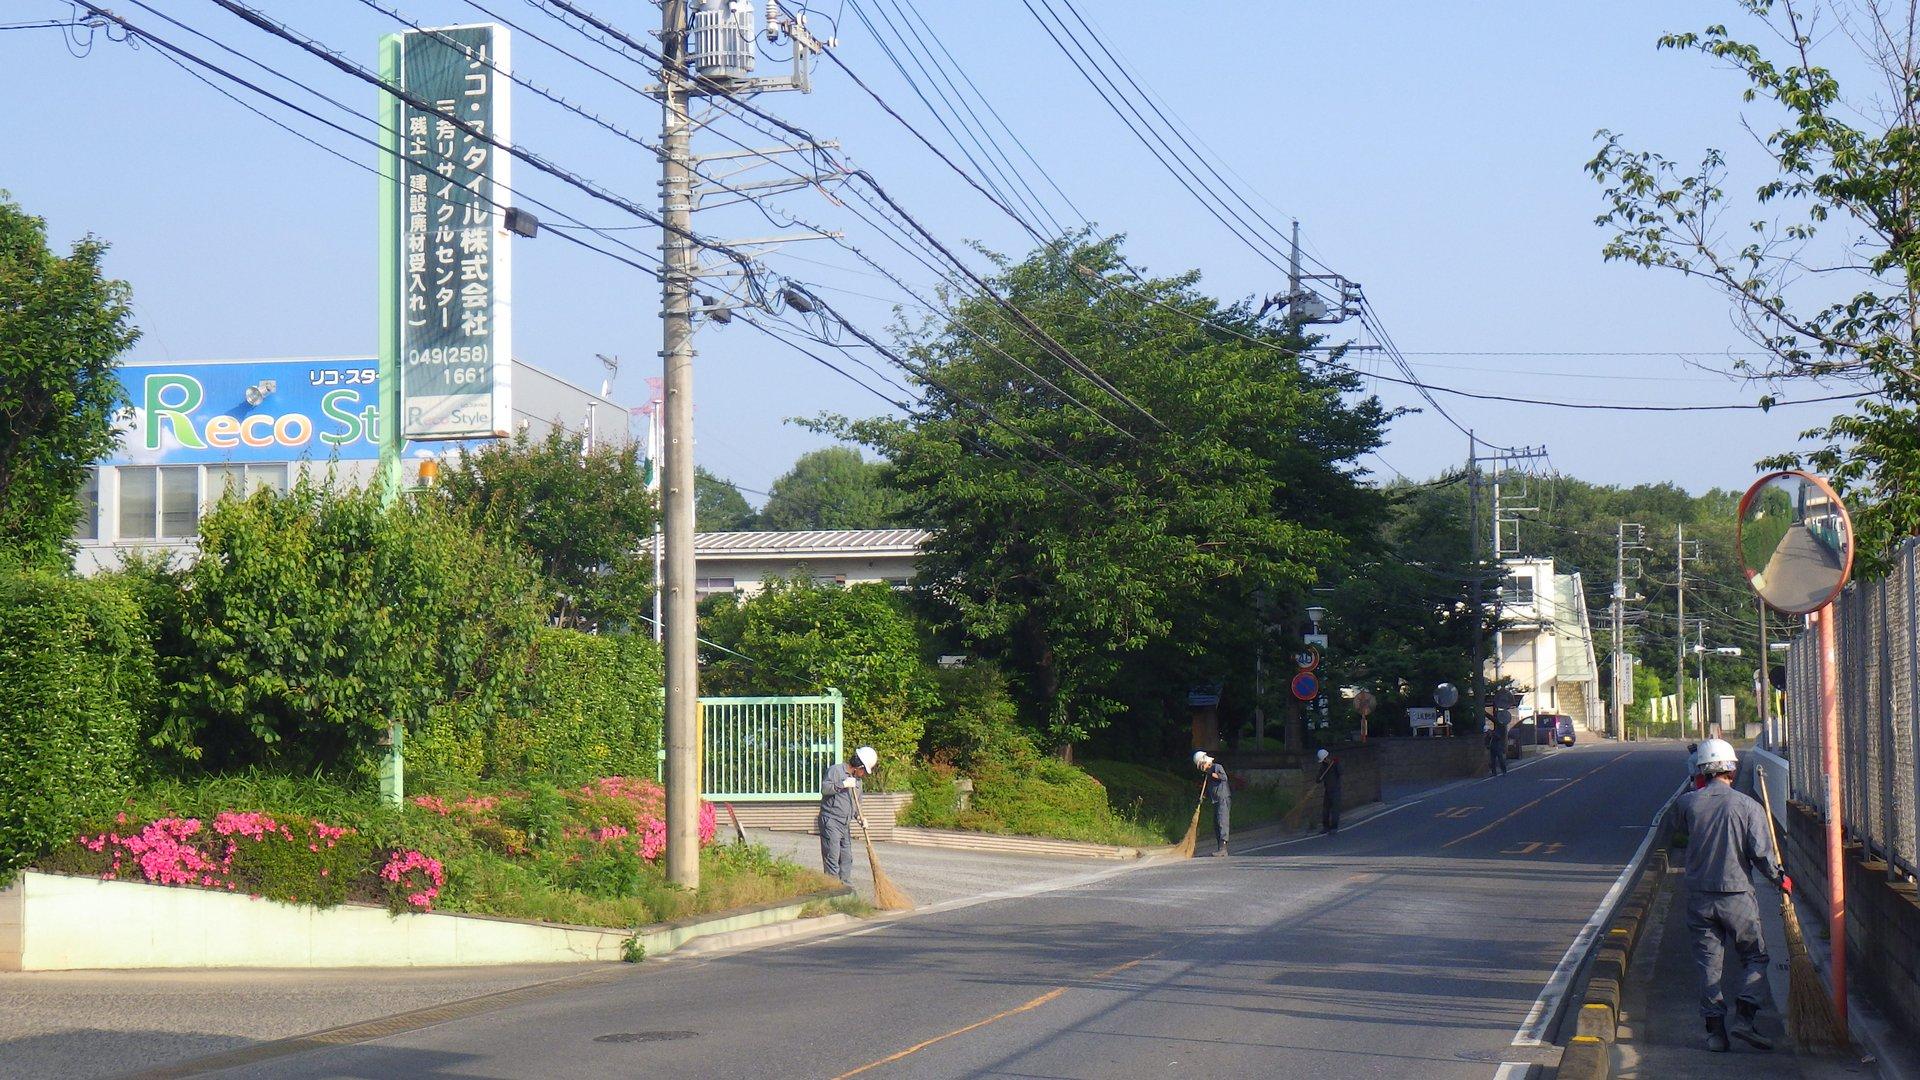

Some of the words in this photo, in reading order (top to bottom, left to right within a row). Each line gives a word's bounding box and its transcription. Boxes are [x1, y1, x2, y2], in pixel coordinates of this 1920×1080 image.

[460, 44, 488, 336] リコ・スタイル株式会社
[435, 99, 455, 328] 三芳リサイクルセンター
[409, 345, 488, 366] 049(258)
[309, 369, 380, 386] リコ・スタ
[444, 368, 485, 386] 1661
[144, 373, 312, 450] Reco
[451, 408, 488, 426] Style
